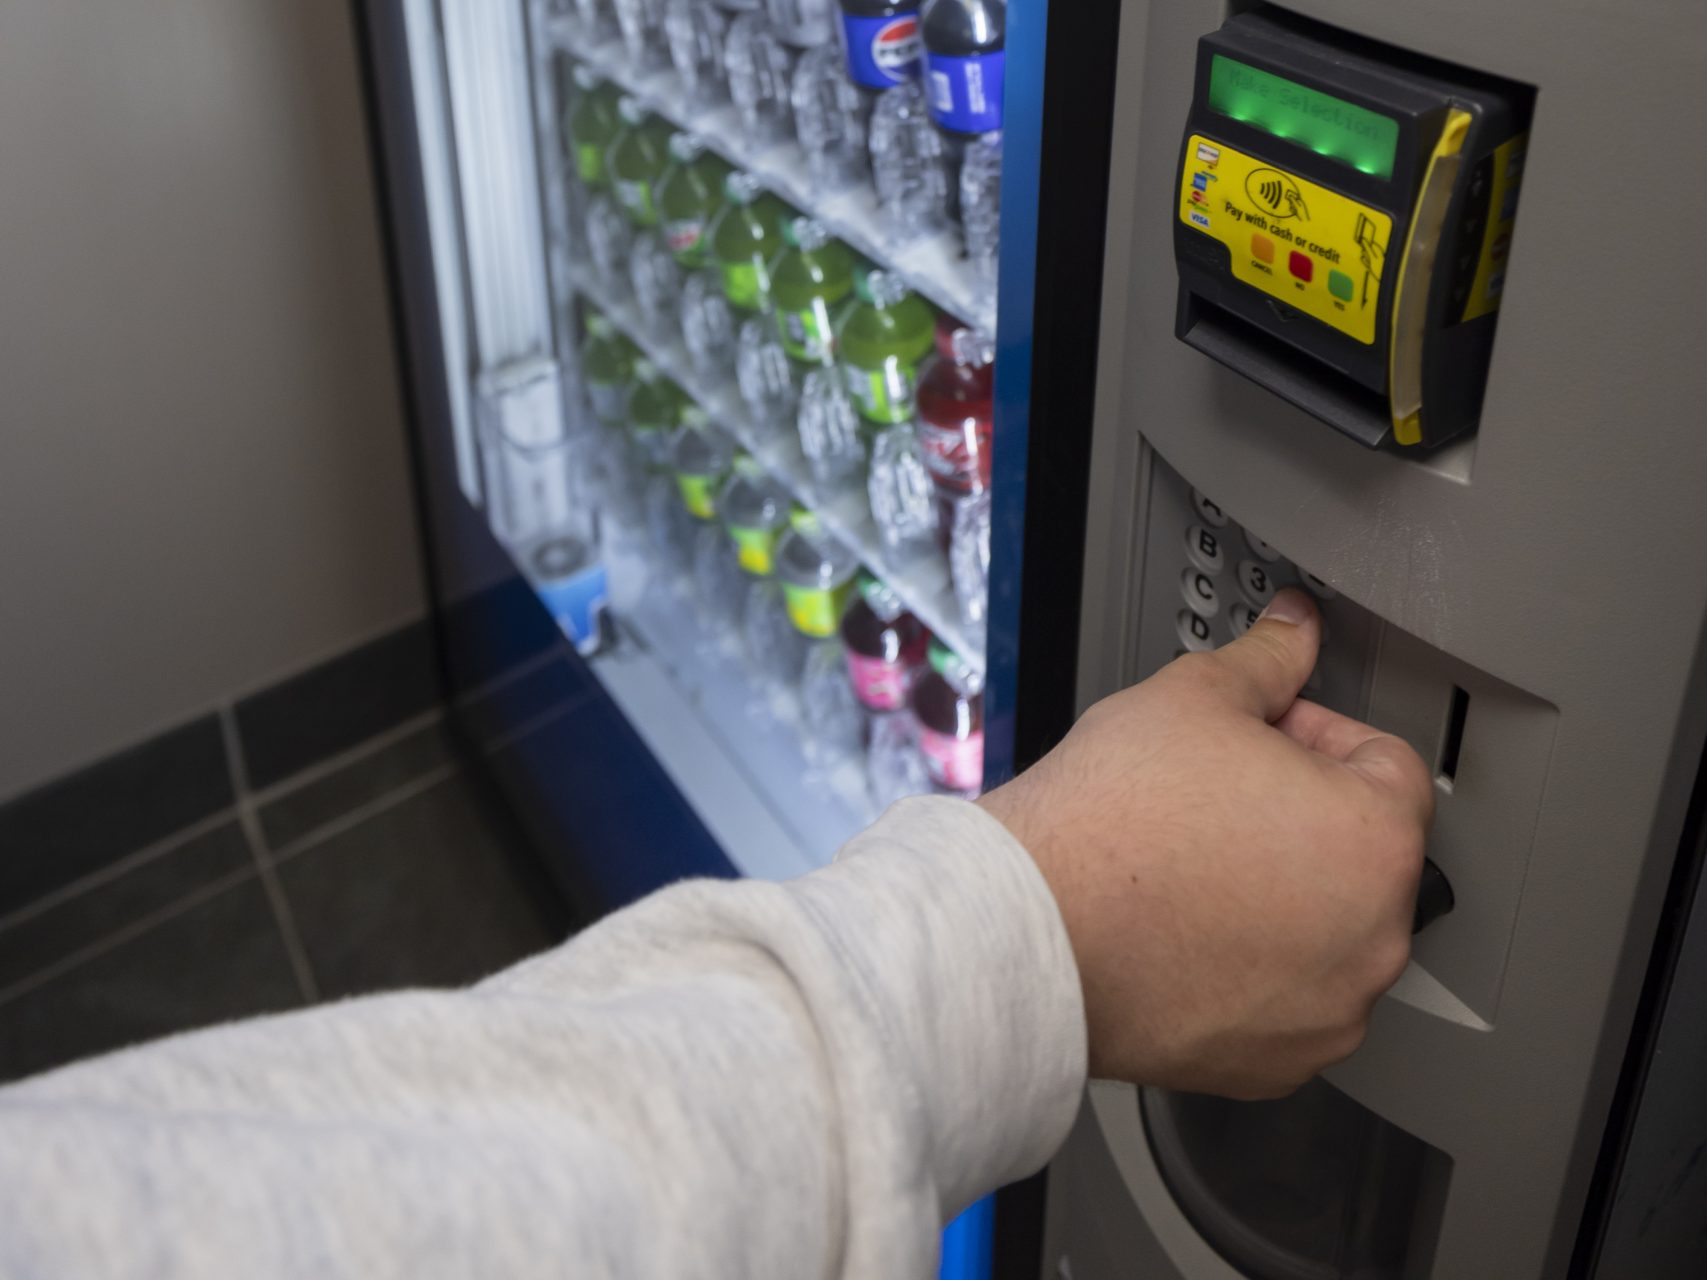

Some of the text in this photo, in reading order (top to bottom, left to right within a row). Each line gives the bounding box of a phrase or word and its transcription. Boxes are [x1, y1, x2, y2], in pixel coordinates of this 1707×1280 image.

[1229, 69, 1379, 140] Make Selection
[1190, 213, 1209, 227] VISA
[1225, 201, 1243, 221] Pay
[1245, 213, 1267, 230] with
[1270, 224, 1292, 241] cash
[1295, 236, 1307, 248] or
[1308, 241, 1340, 264] credit
[1199, 529, 1217, 558] B
[1195, 573, 1214, 600] C
[1250, 566, 1266, 593] 3
[1191, 613, 1209, 641] D
